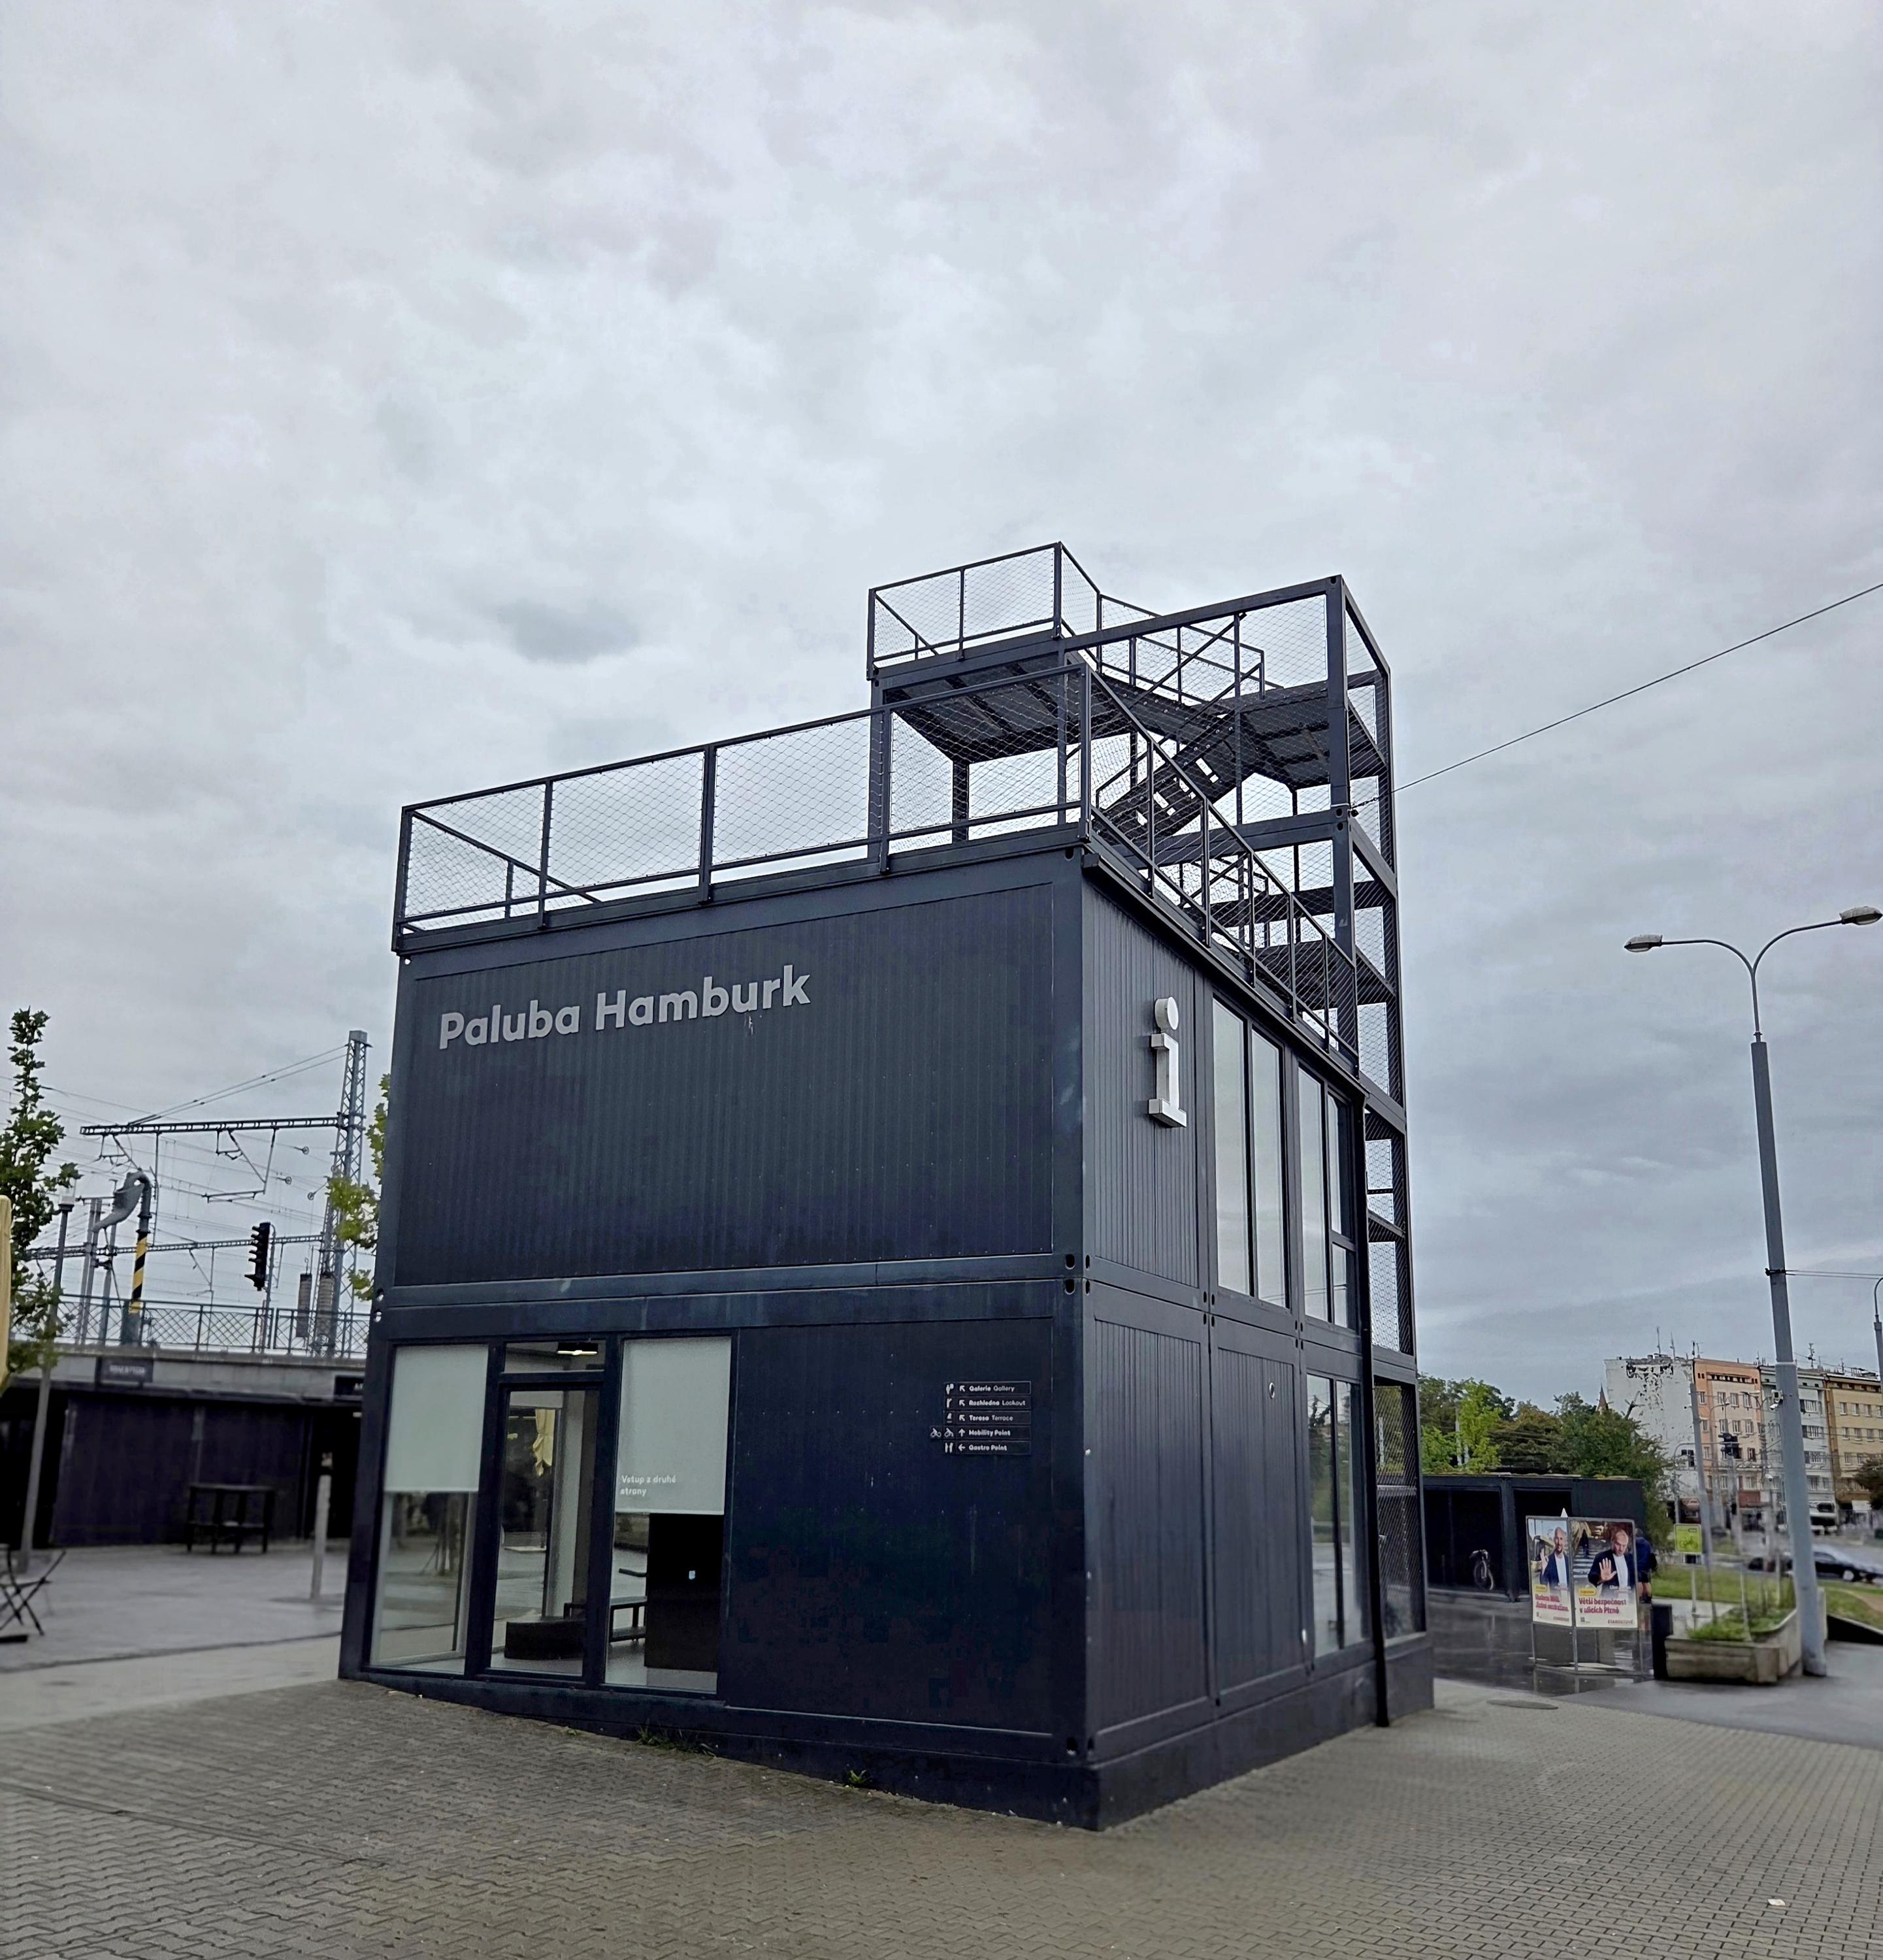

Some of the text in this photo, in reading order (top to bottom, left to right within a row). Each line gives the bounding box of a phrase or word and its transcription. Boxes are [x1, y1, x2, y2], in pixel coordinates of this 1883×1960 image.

[439, 964, 810, 1050] Paluba Hamburk
[993, 1384, 1015, 1393] Gallery
[621, 1475, 644, 1484] Vstup
[653, 1475, 676, 1484] druhé
[620, 1487, 647, 1497] strany
